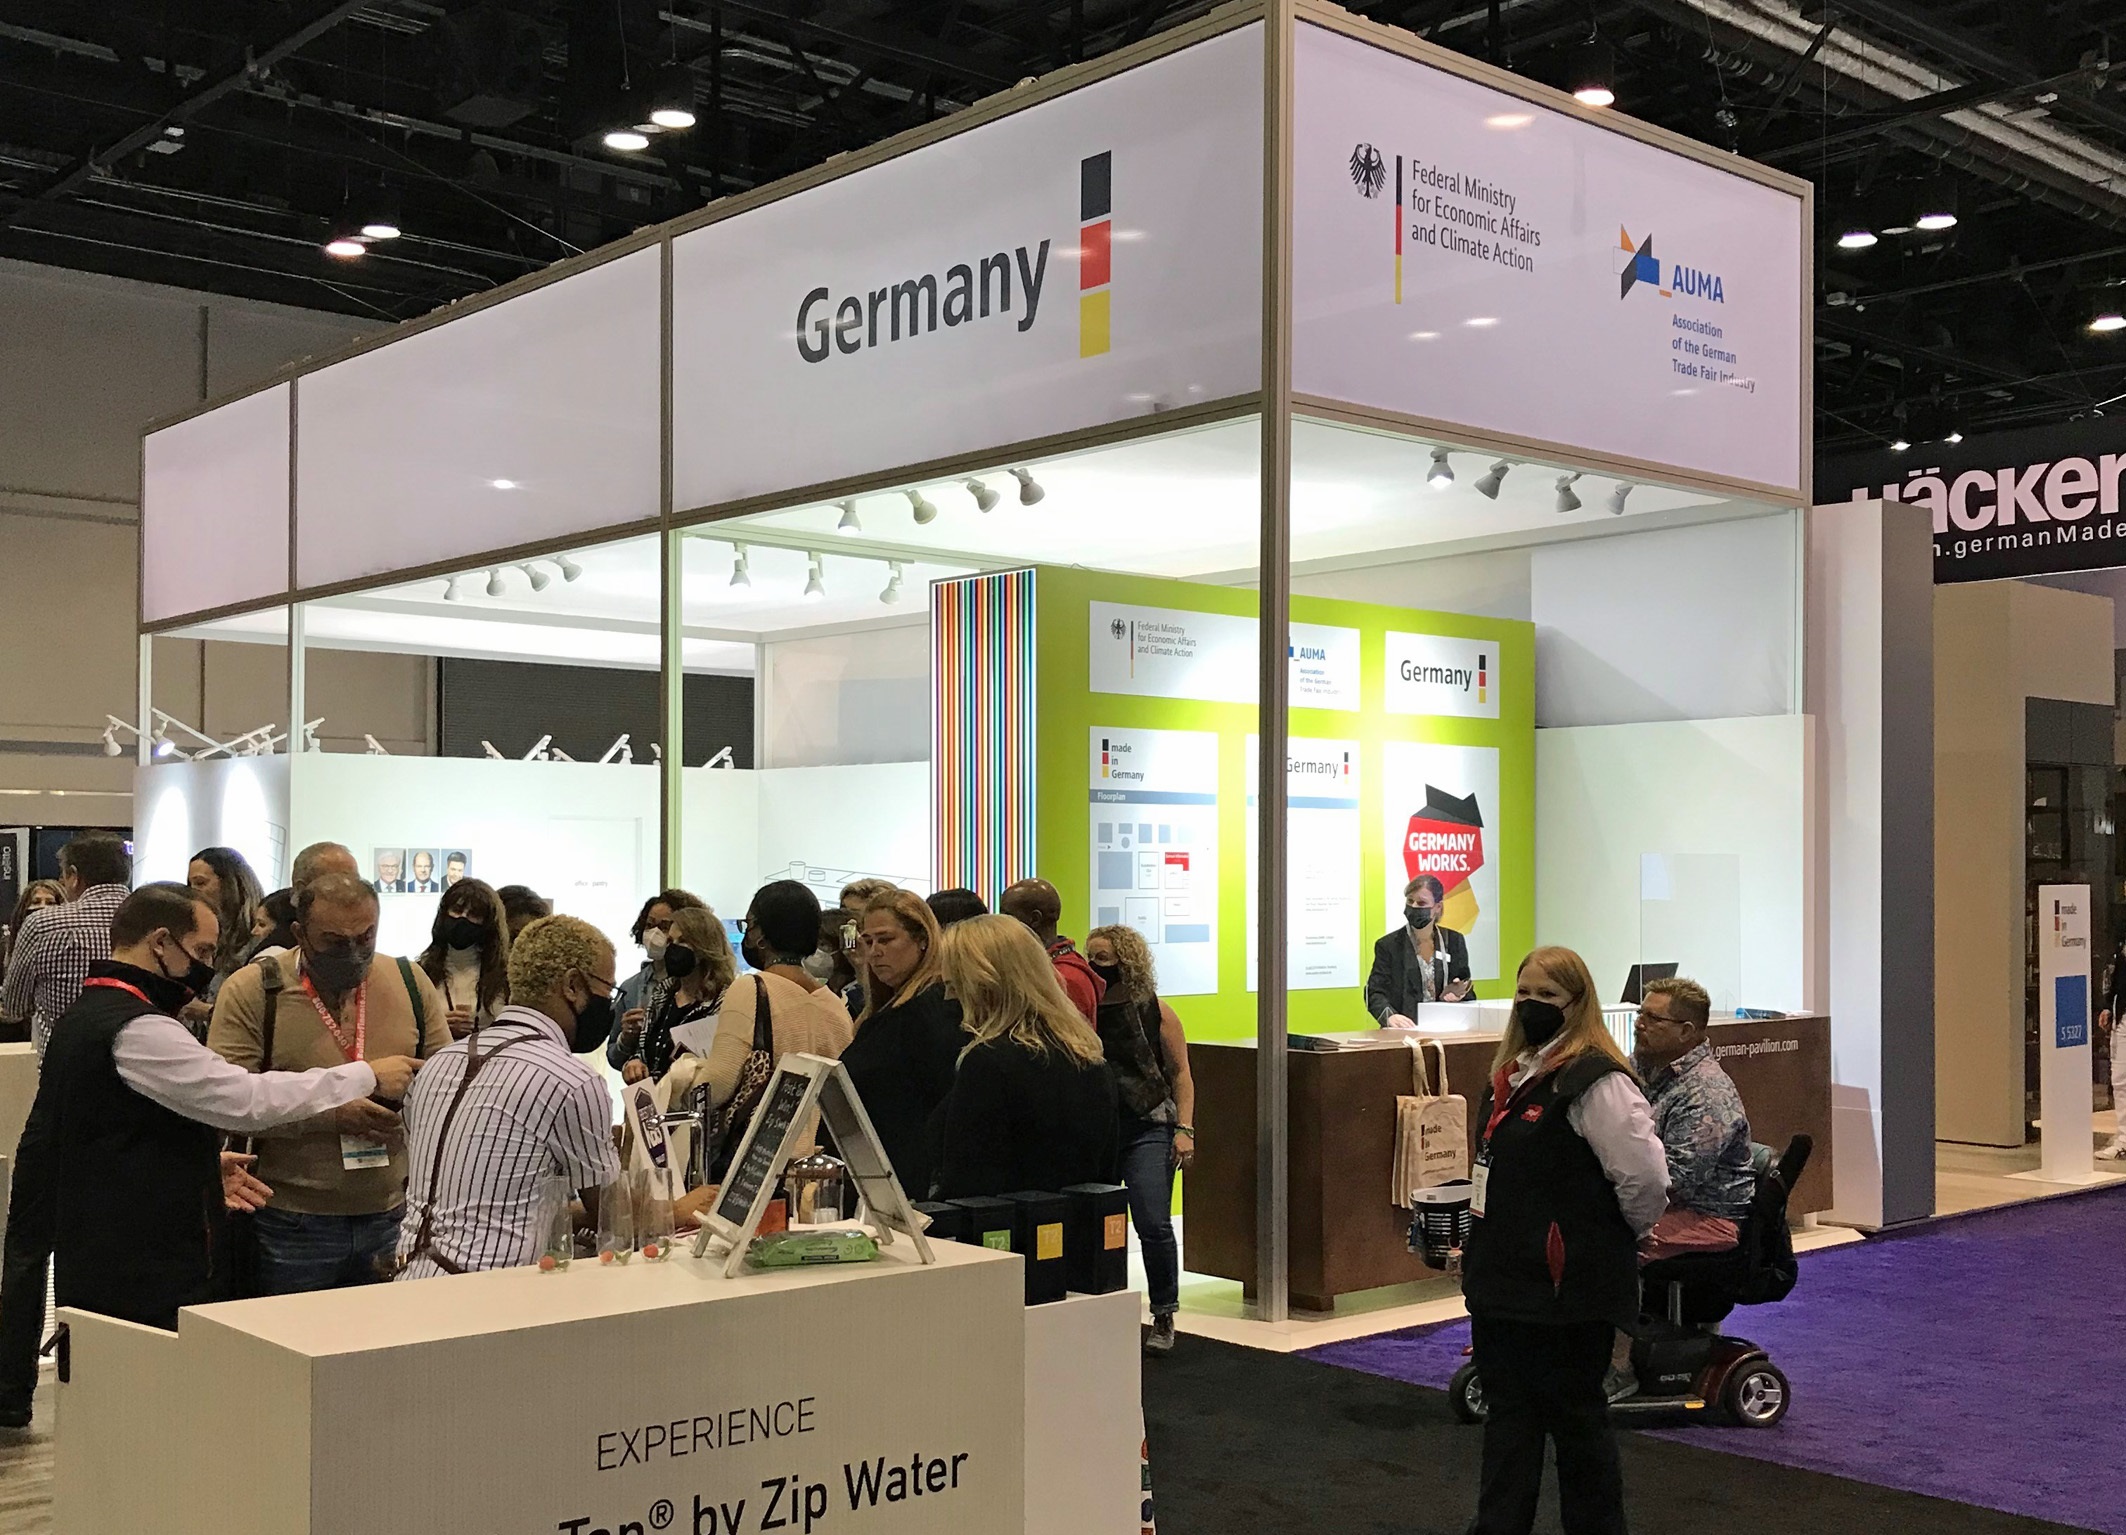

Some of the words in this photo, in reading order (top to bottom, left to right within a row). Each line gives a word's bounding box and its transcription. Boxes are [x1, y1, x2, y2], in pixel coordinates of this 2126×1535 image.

[1412, 160, 1461, 194] Federal
[1465, 175, 1516, 215] Ministry
[1412, 189, 1431, 213] for
[1435, 196, 1497, 234] Economic
[1501, 216, 1541, 246] Affairs
[1412, 224, 1436, 245] and
[1440, 227, 1489, 260] Climate
[1493, 242, 1533, 272] Action
[1672, 264, 1724, 304] AUMA
[797, 239, 1050, 363] Germany
[1672, 314, 1723, 339] Association
[1672, 337, 1682, 350] of
[1684, 340, 1700, 355] the
[1702, 344, 1737, 364] German
[1672, 358, 1698, 377] Trade
[1700, 365, 1717, 382] Fair
[1720, 370, 1755, 393] Industry
[1852, 453, 2126, 533] äcker
[1138, 621, 1159, 632] Federal
[1161, 624, 1185, 636] Ministry
[1138, 632, 1146, 641] for
[1148, 633, 1176, 645] Economic
[1178, 637, 1196, 647] Affairs
[1138, 645, 1149, 653] and
[1150, 645, 1173, 656] Climate
[1174, 648, 1193, 657] Action
[1300, 647, 1326, 660] AUMA
[1400, 660, 1472, 691] Germany
[1111, 743, 1132, 752] made
[1111, 755, 1118, 765] in
[1287, 757, 1338, 778] Germany
[1112, 769, 1144, 782] Germany
[1097, 792, 1126, 802] Floorplan
[1409, 832, 1476, 851] GERMANY
[1418, 853, 1471, 872] WORKS.
[2061, 903, 2077, 915] made
[2061, 920, 2067, 931] in
[2061, 935, 2086, 949] Germany
[2067, 1025, 2082, 1039] 5327
[1109, 1221, 1121, 1235] T2
[989, 1236, 1005, 1249] T2
[597, 1397, 815, 1471] EXPERIENCE
[760, 1475, 828, 1534] Zip
[844, 1452, 968, 1511] Water
